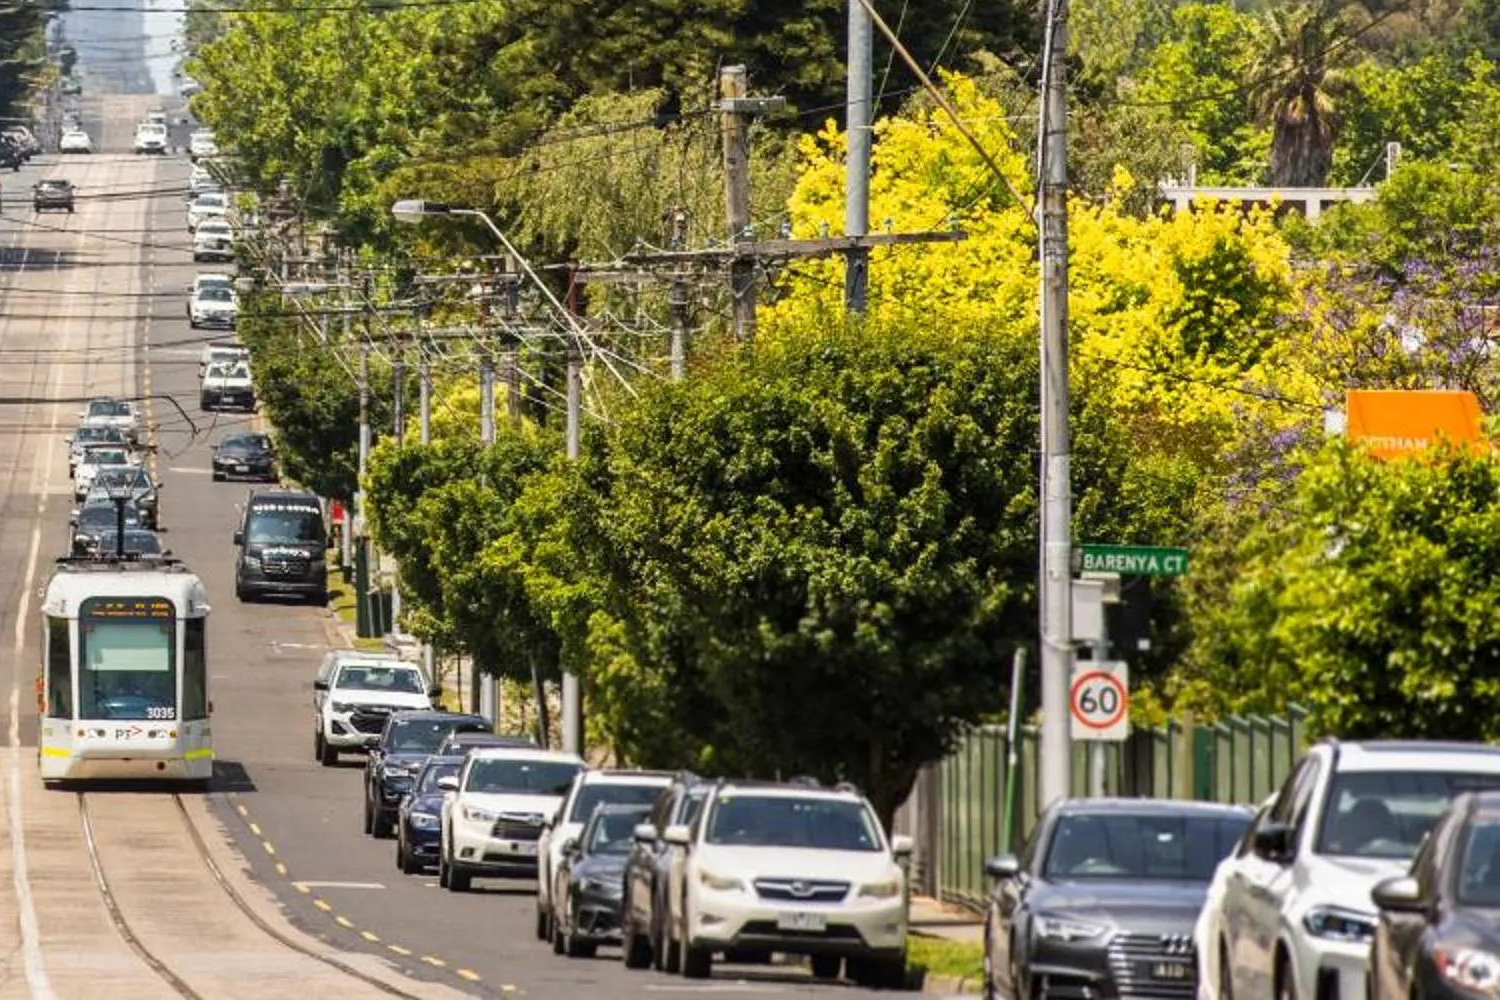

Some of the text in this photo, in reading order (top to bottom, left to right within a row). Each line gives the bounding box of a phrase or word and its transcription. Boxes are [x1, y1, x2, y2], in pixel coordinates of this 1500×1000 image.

[1083, 553, 1184, 572] BARENYA CT
[1080, 686, 1118, 715] 60
